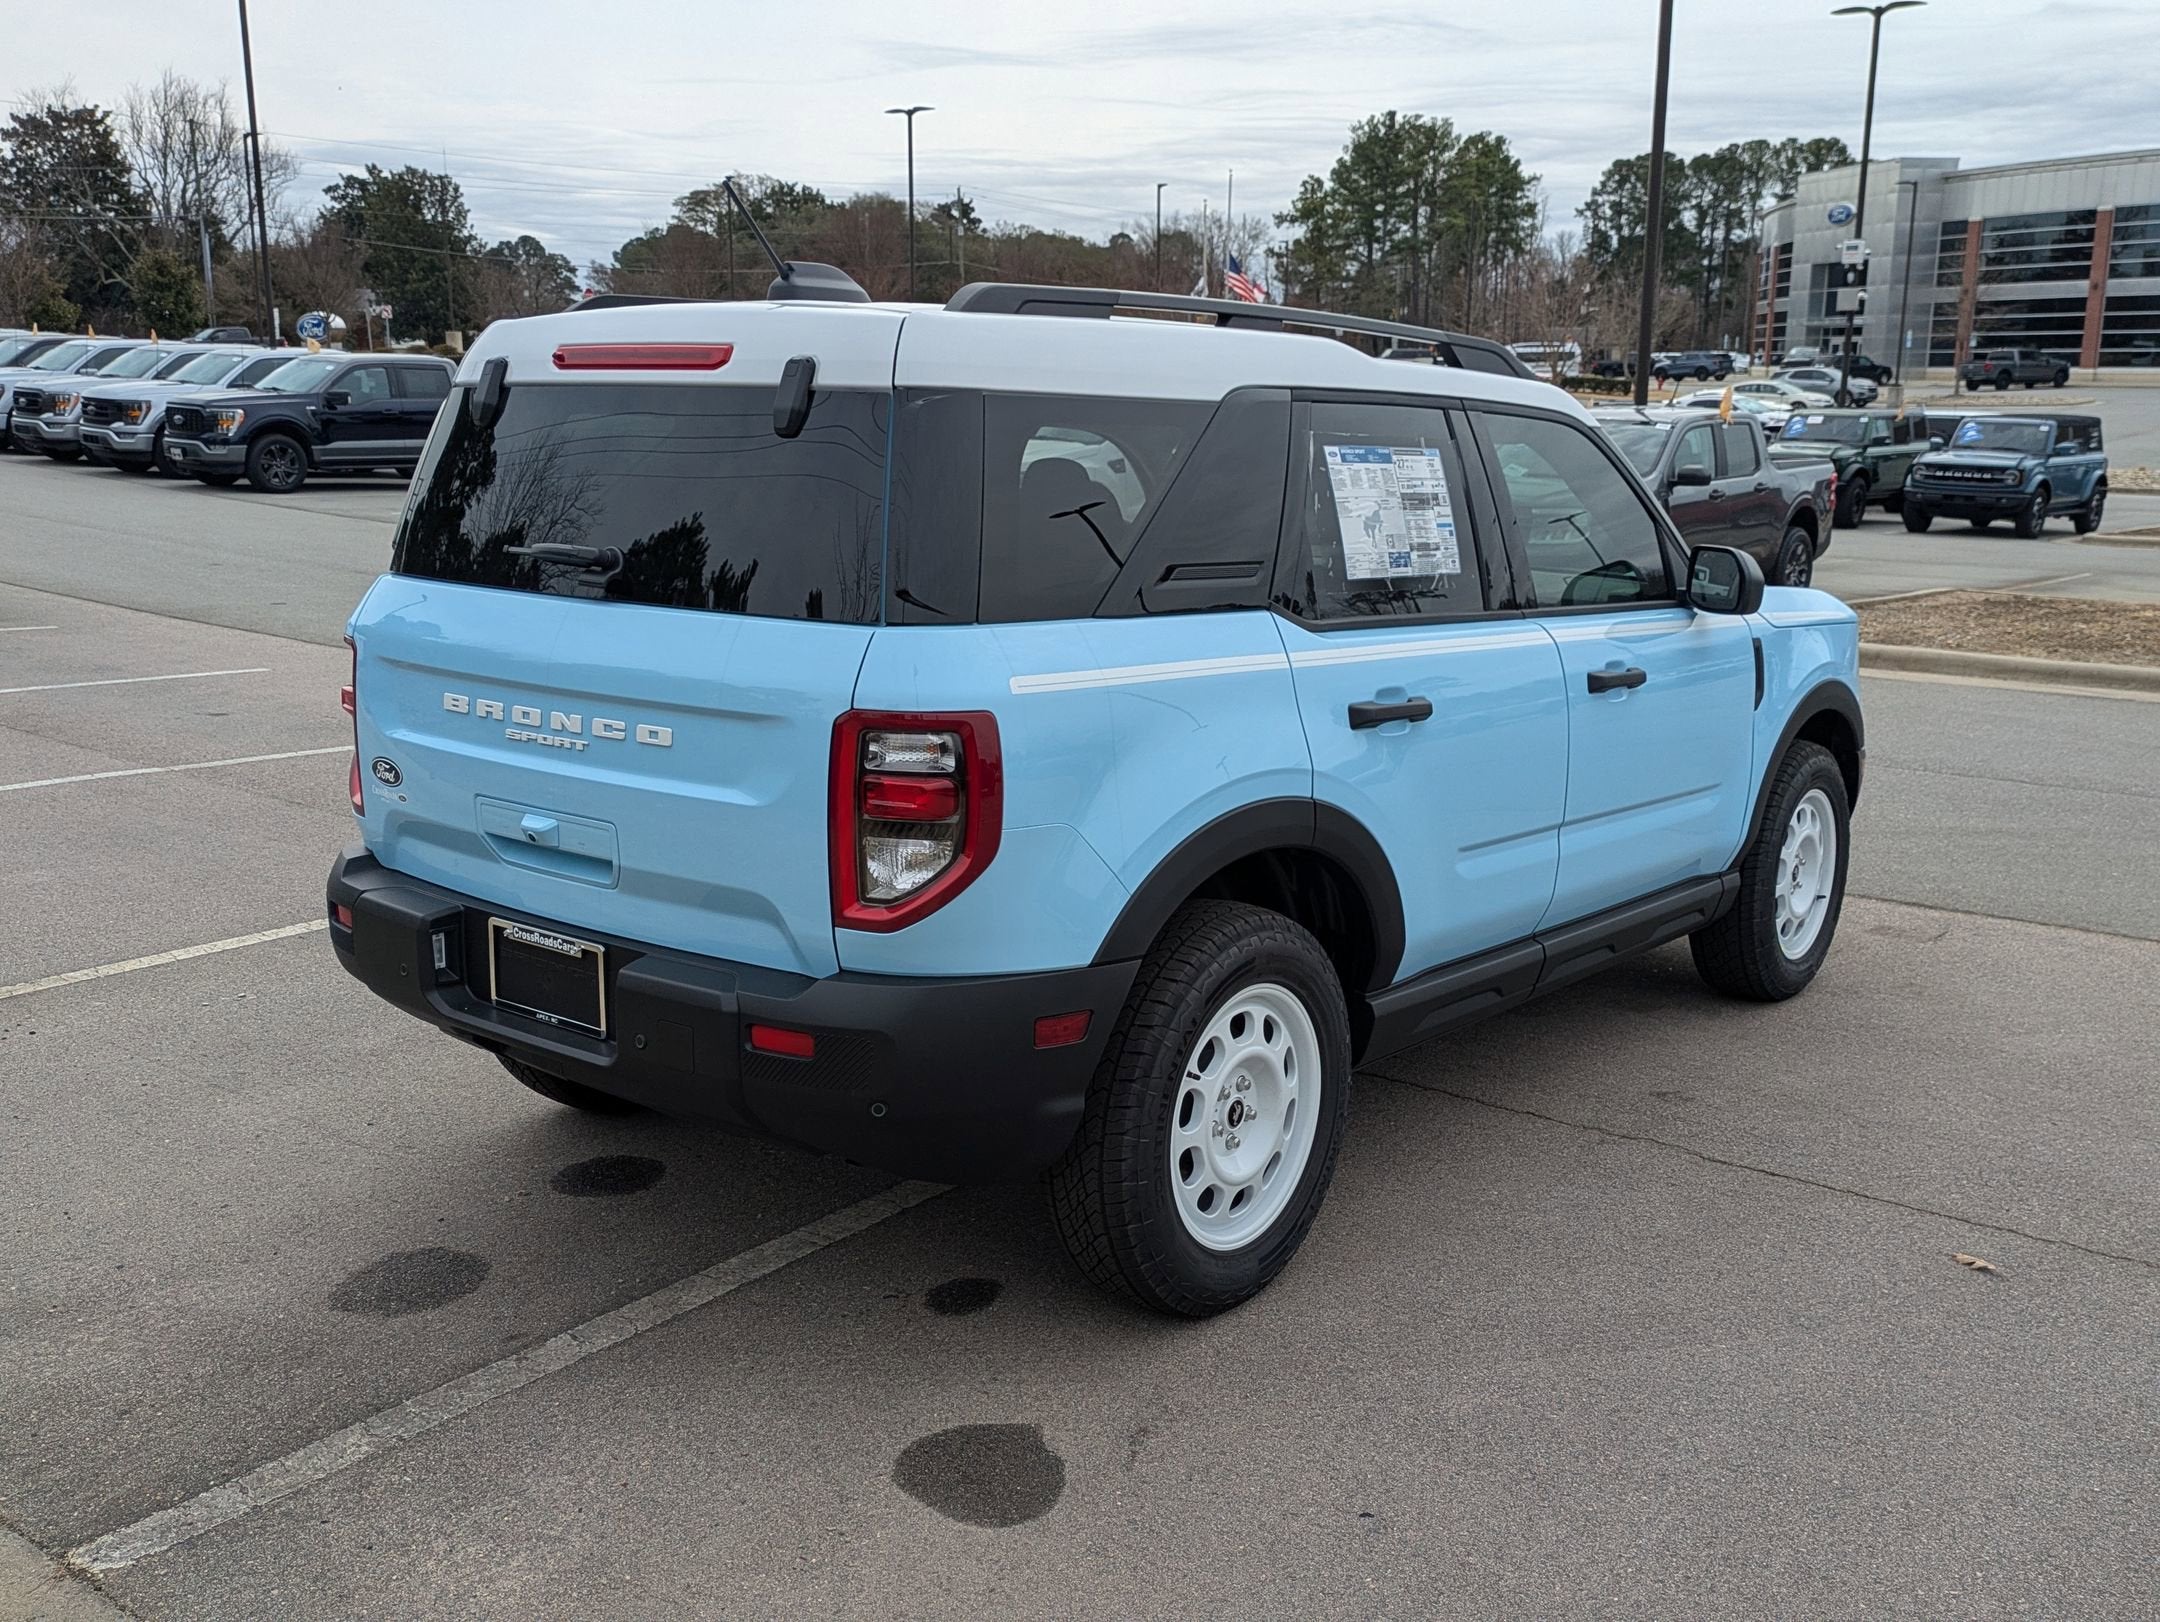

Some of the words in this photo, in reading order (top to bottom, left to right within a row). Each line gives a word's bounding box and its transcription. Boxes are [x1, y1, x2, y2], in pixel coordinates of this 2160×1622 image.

[303, 319, 325, 337] Ford
[442, 691, 674, 748] BRONCO
[504, 728, 590, 751] SPORT
[375, 761, 396, 783] Ford
